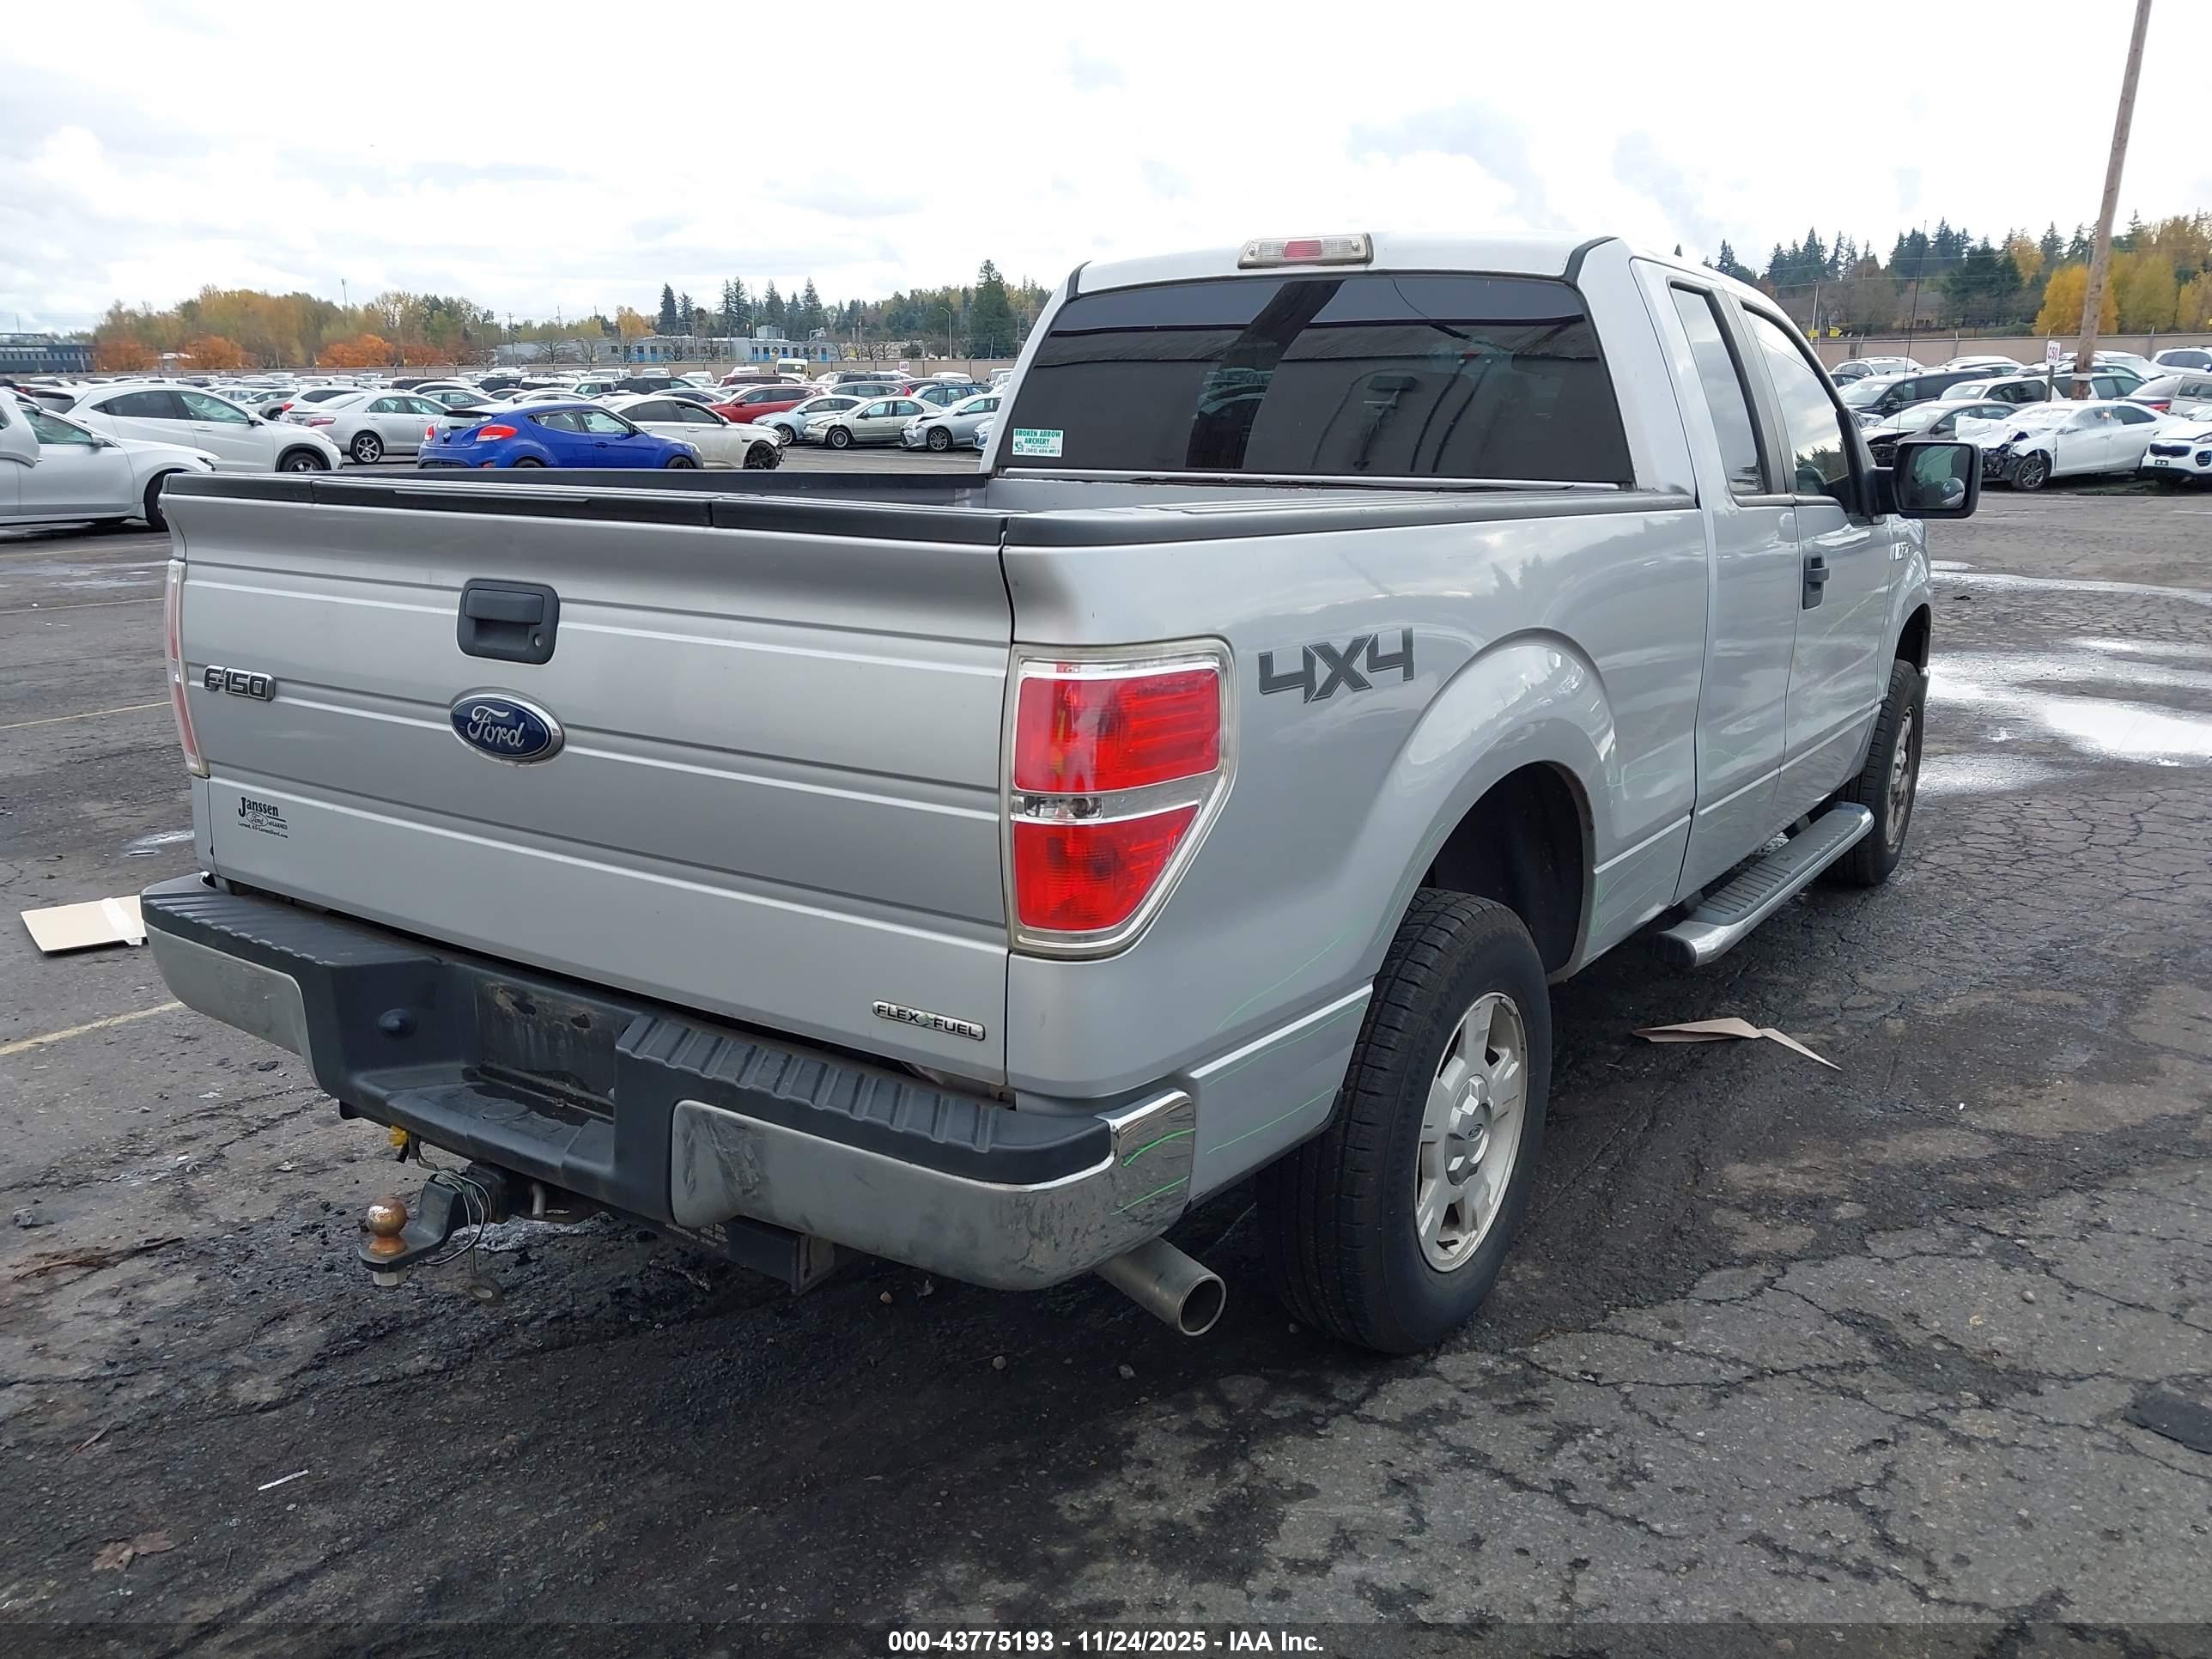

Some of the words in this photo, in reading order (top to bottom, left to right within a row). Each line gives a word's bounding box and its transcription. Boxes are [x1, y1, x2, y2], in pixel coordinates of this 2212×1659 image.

[466, 704, 526, 748] Ford
[238, 797, 279, 817] Janssen
[877, 1004, 920, 1024] FLEX
[933, 1018, 978, 1037] FUEL
